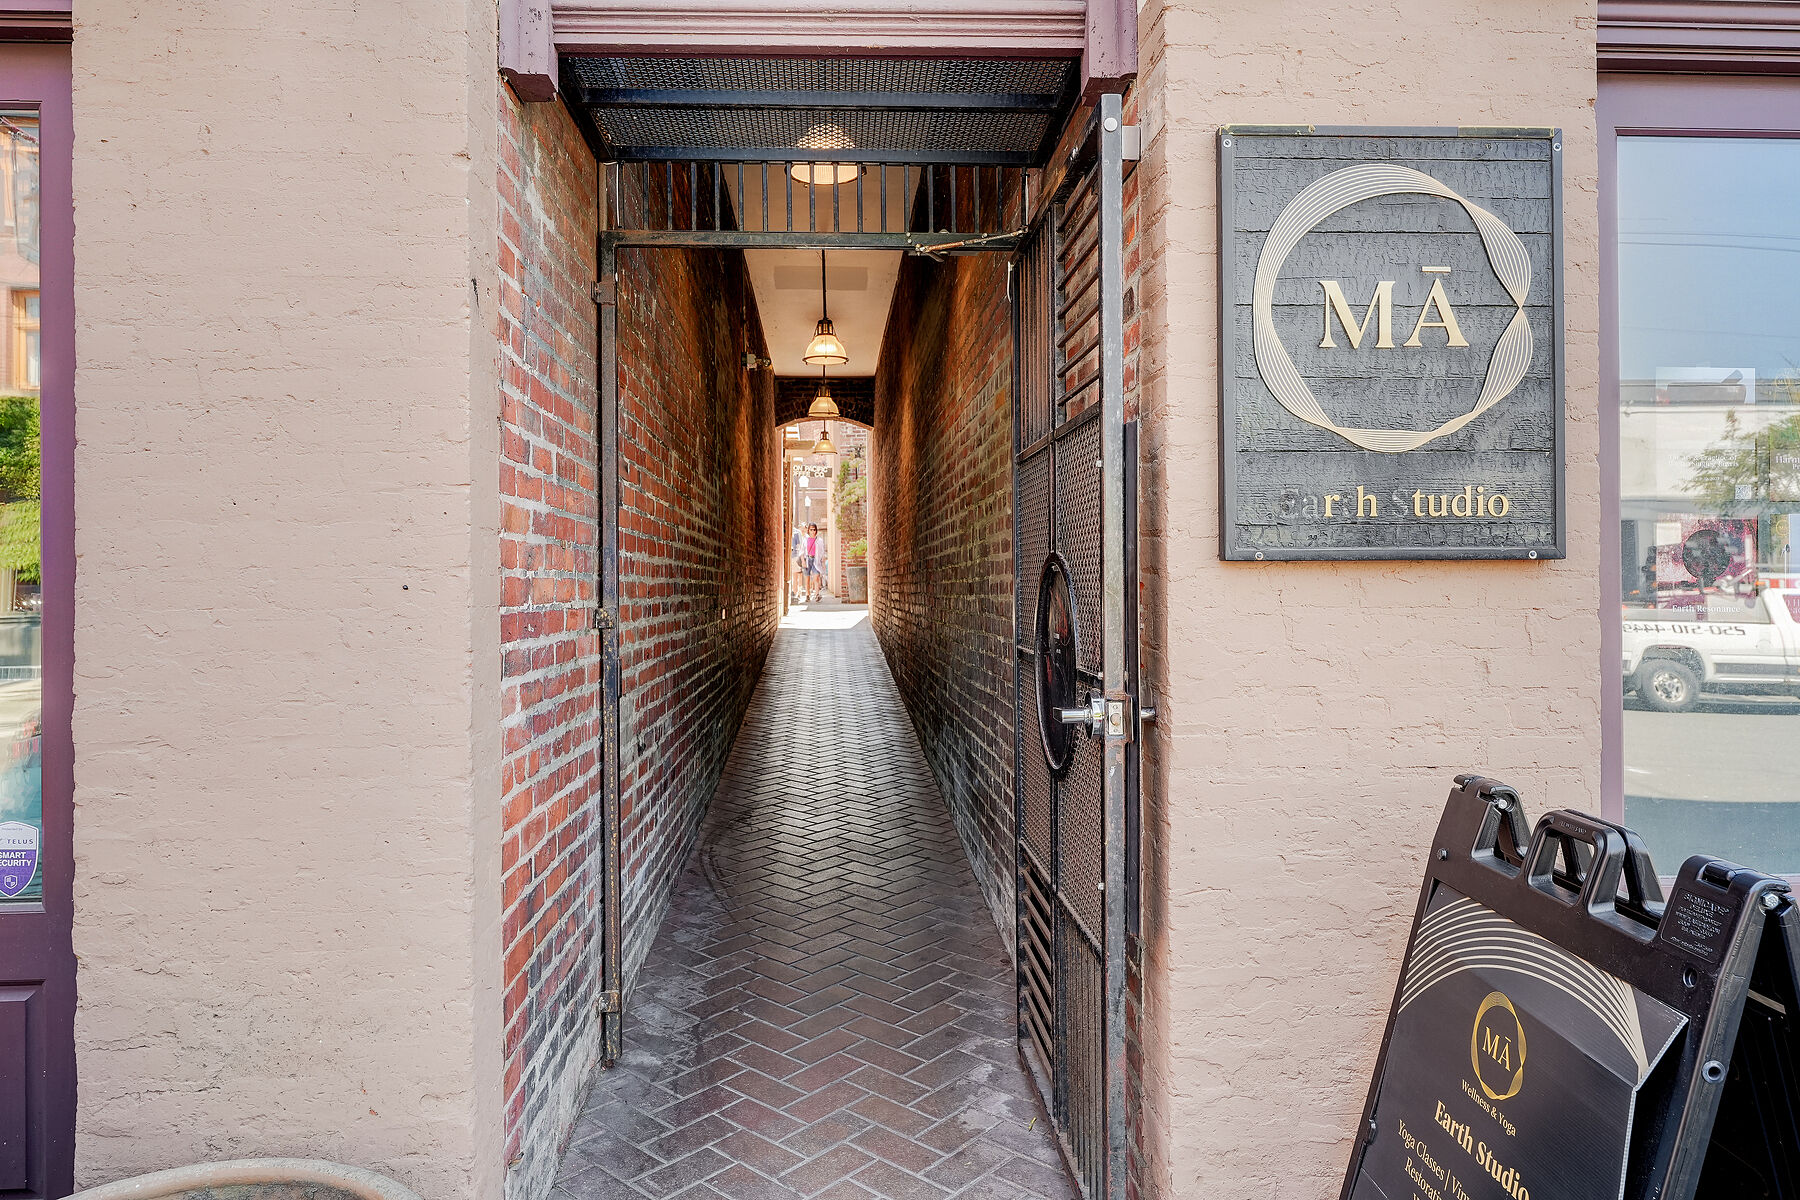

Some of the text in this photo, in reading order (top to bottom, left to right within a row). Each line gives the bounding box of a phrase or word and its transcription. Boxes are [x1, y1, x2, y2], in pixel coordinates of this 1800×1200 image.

[1672, 604, 1741, 613] Earth Resonance
[1461, 1078, 1517, 1137] Wellness & Yoga
[1398, 1118, 1416, 1150] Yoga
[1416, 1140, 1445, 1181] Classes
[1434, 1099, 1531, 1200] Earth Studio
